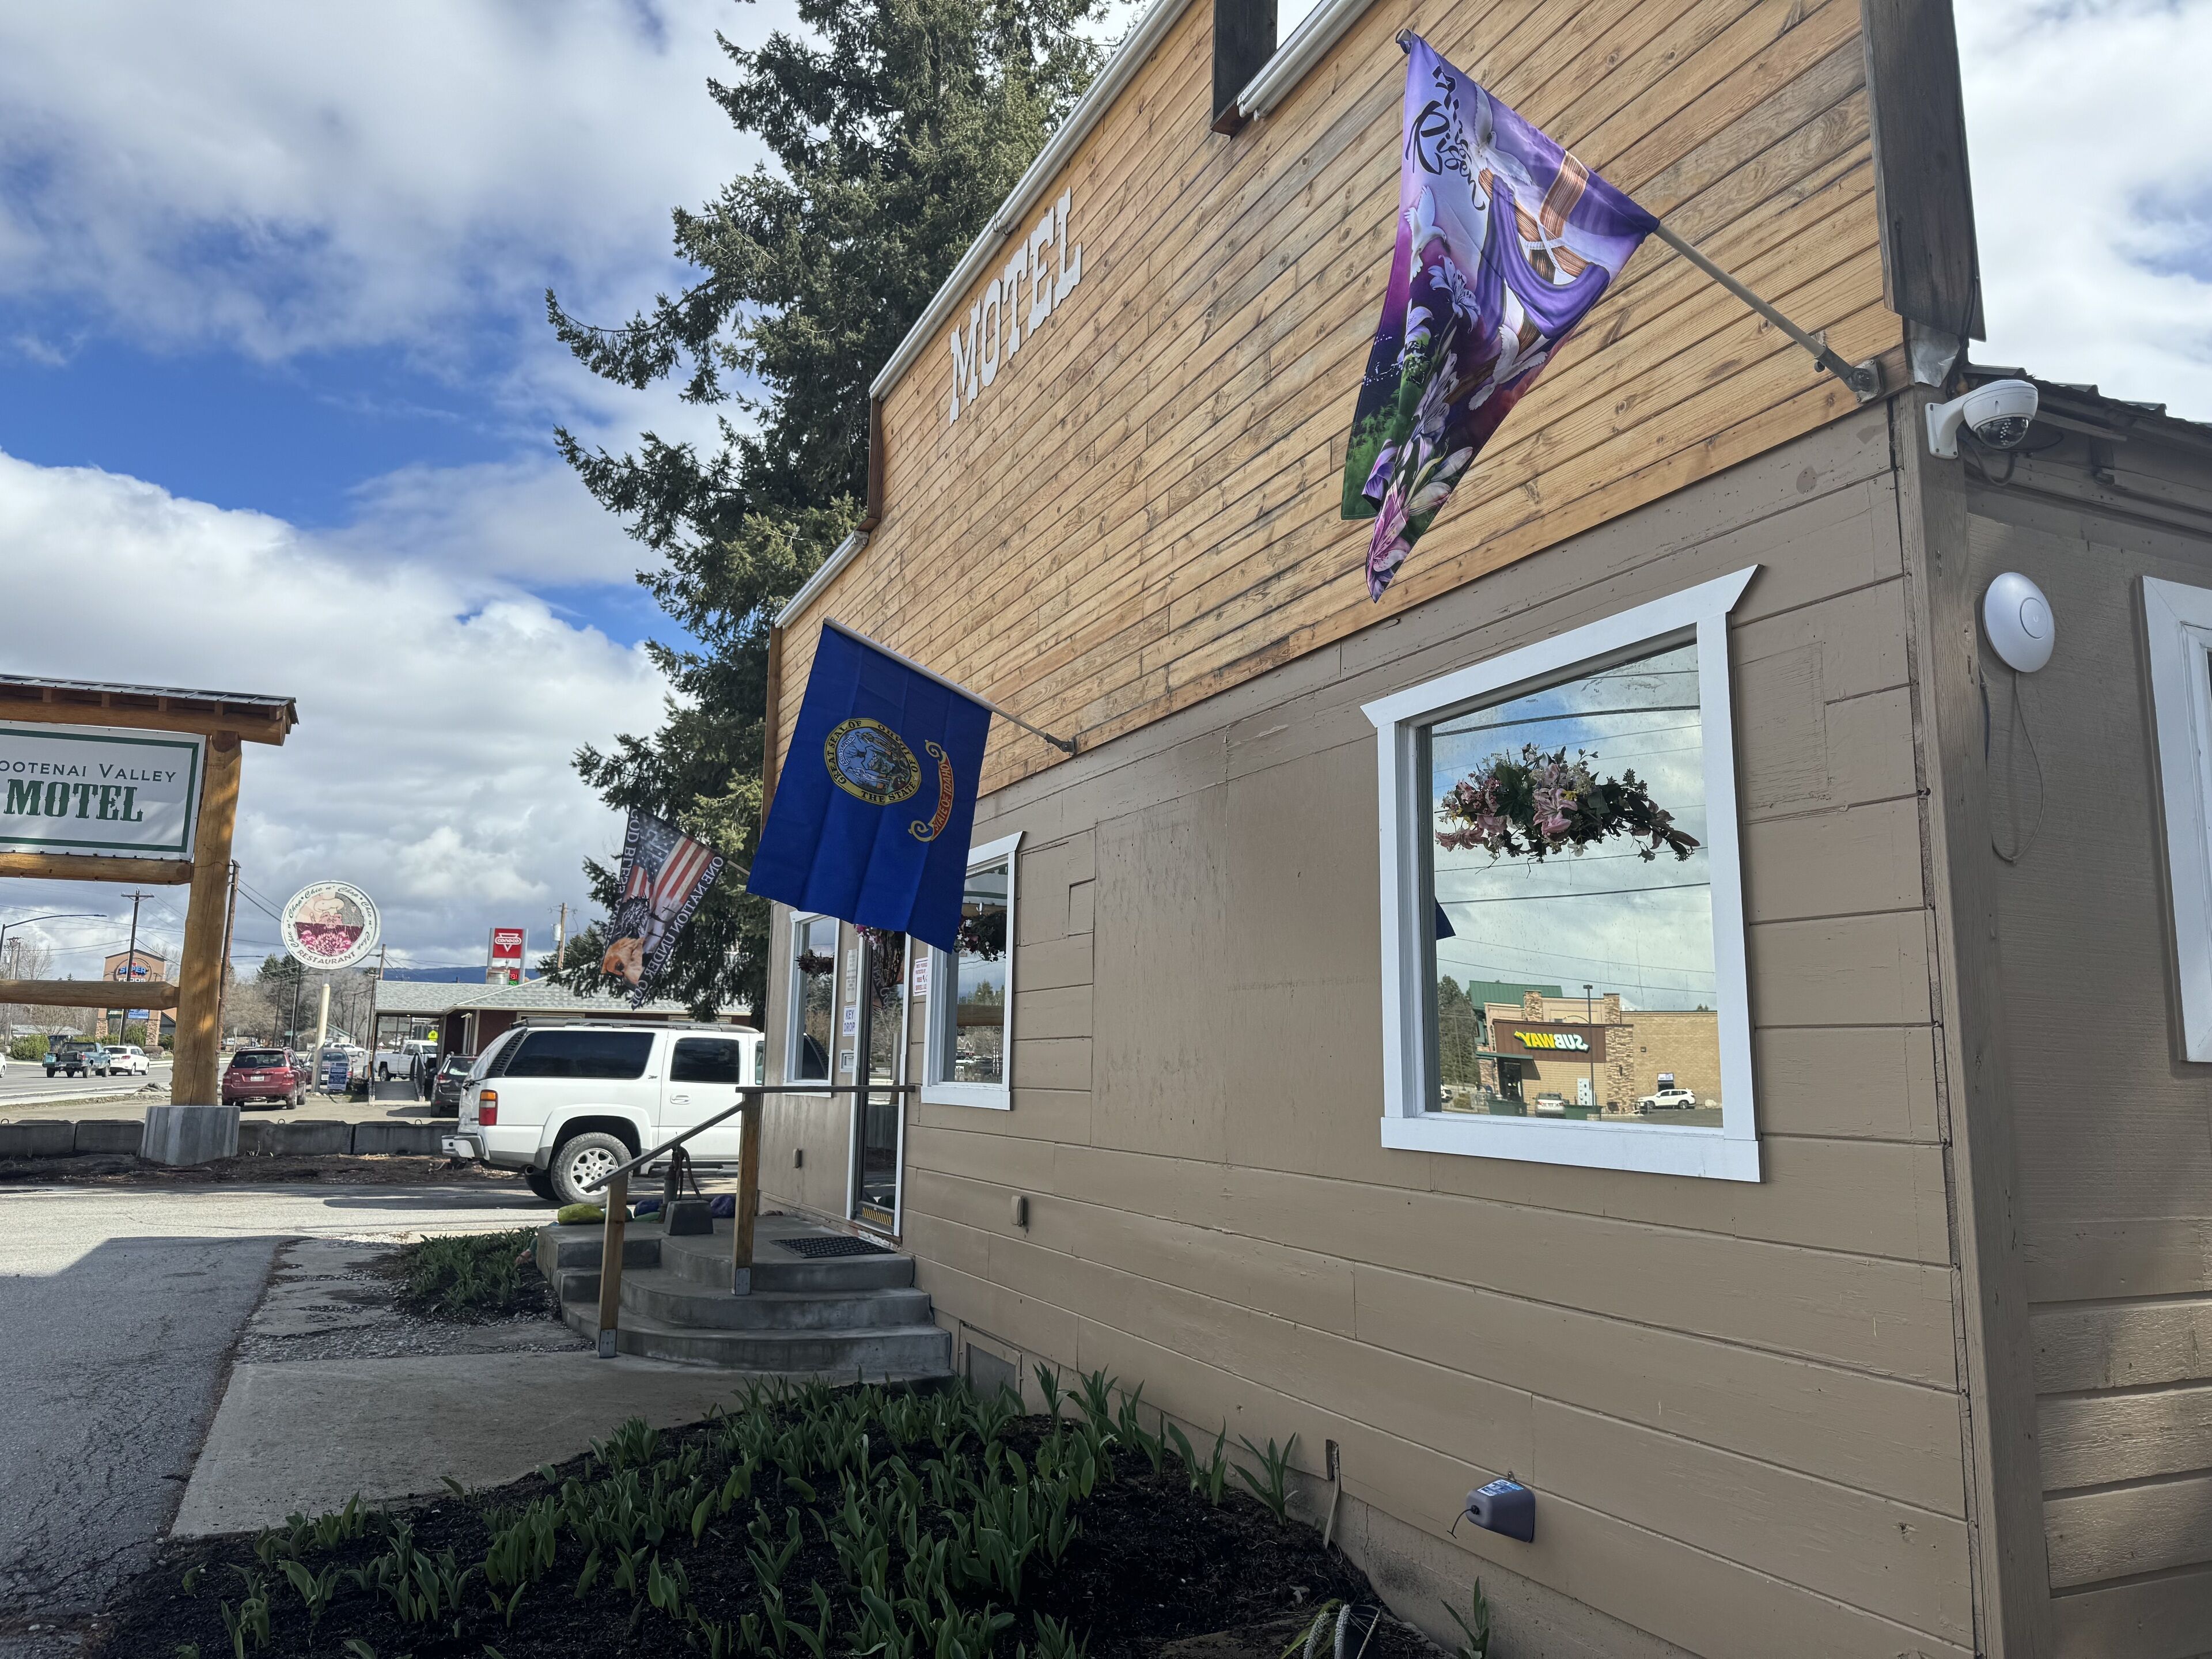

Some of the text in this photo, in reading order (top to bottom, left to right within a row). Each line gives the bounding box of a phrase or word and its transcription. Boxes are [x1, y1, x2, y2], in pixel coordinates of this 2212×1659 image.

[1405, 100, 1486, 211] Risen
[949, 185, 1082, 426] MOTEL
[827, 720, 862, 785] GREAT SEAL OF
[99, 764, 176, 782] VALLEY
[861, 790, 885, 803] THE
[888, 782, 916, 801] STATE
[908, 759, 918, 772] OF
[940, 764, 952, 796] IDAHO
[3, 779, 143, 822] MOTEL
[305, 887, 322, 898] Chic
[338, 887, 358, 897] Chop
[289, 900, 302, 918] Chop
[361, 902, 371, 916] Chic
[358, 931, 370, 950] Chop
[297, 950, 355, 964] RESTAURANT
[846, 1009, 854, 1020] KEY
[844, 1022, 855, 1032] DROP
